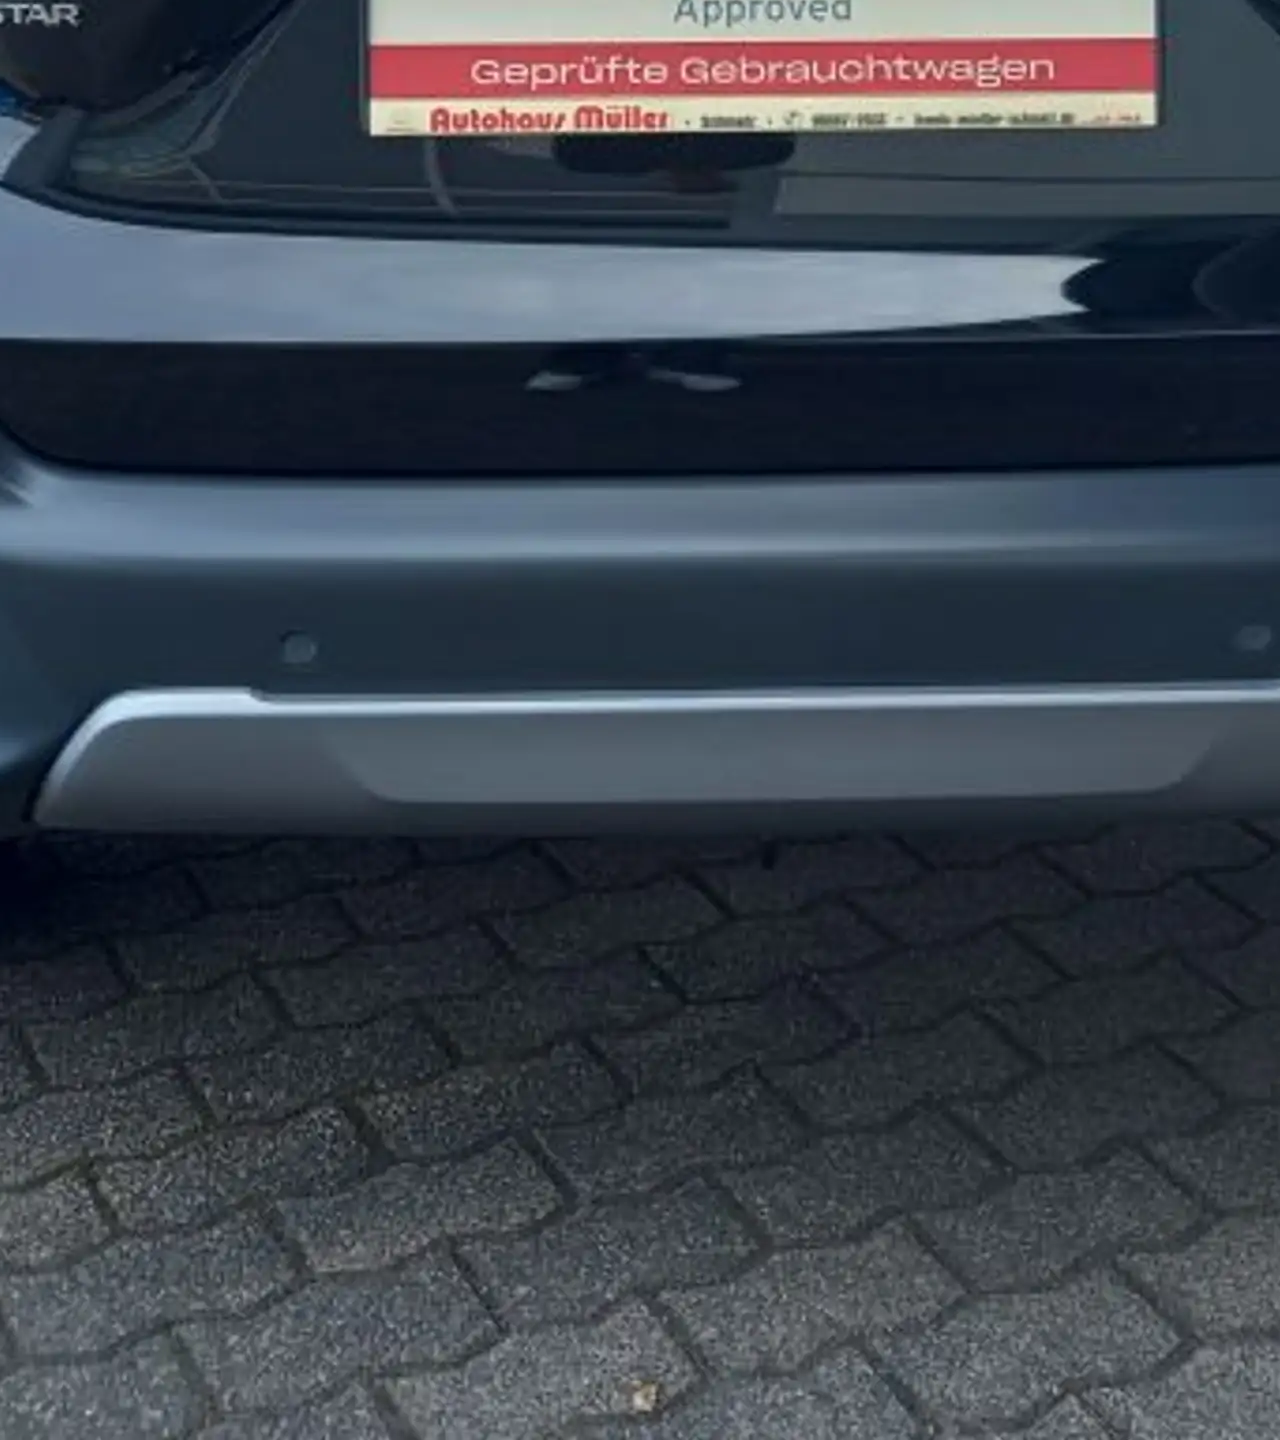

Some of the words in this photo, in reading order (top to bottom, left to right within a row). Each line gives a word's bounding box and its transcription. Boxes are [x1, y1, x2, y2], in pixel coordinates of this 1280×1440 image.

[470, 55, 668, 90] Geprüfte
[680, 53, 1055, 88] Gebrauchtwagen
[430, 107, 567, 133] Autohaus
[573, 105, 669, 131] Müller
